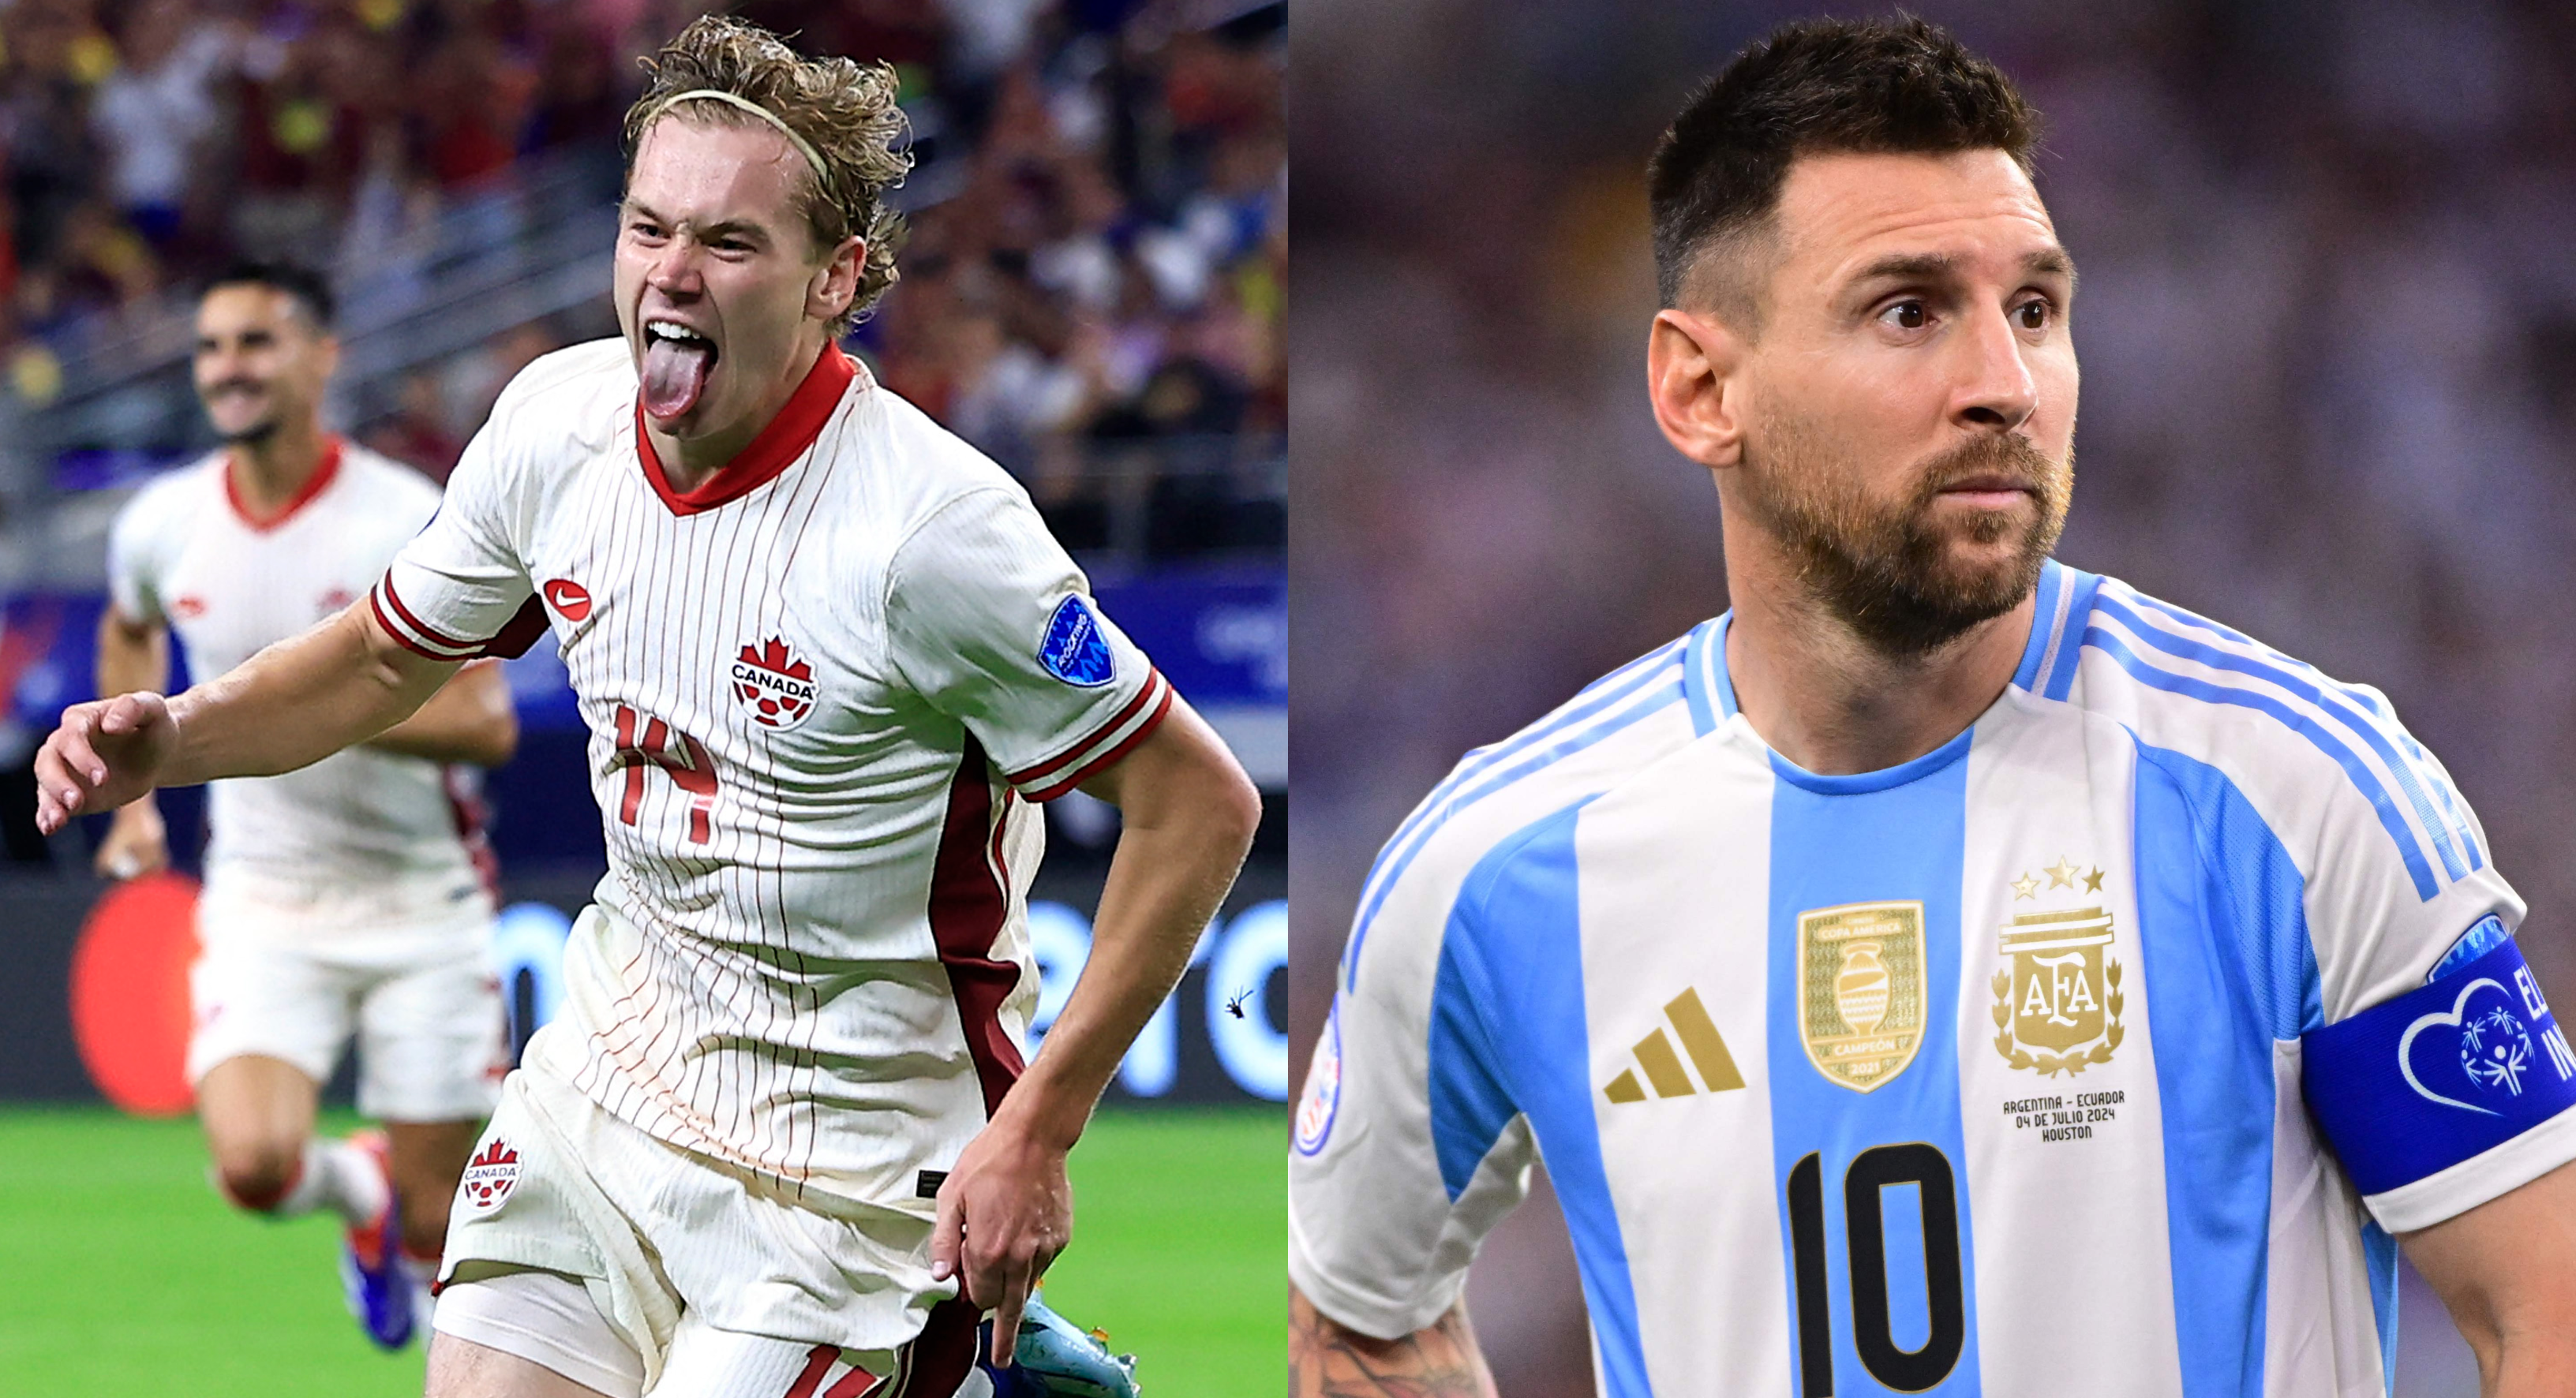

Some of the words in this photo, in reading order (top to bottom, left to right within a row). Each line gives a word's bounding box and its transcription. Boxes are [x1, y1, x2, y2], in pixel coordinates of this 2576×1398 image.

[731, 663, 814, 701] CANADA
[614, 704, 719, 846] 14
[1822, 927, 1851, 939] COPA
[2020, 951, 2099, 1027] AFA
[1834, 1037, 1895, 1056] CAMPEÓN
[1851, 1061, 1880, 1075] 2021
[2003, 1096, 2062, 1115] ARGENTINA
[2076, 1090, 2125, 1108] ECUADOR
[2016, 1116, 2031, 1129] 04
[2035, 1113, 2048, 1127] DE
[2052, 1110, 2084, 1126] JULIO
[2087, 1108, 2115, 1123] 2024
[2042, 1125, 2092, 1142] HOUSTON
[465, 1167, 517, 1180] CANADA
[1785, 1141, 1966, 1398] 10
